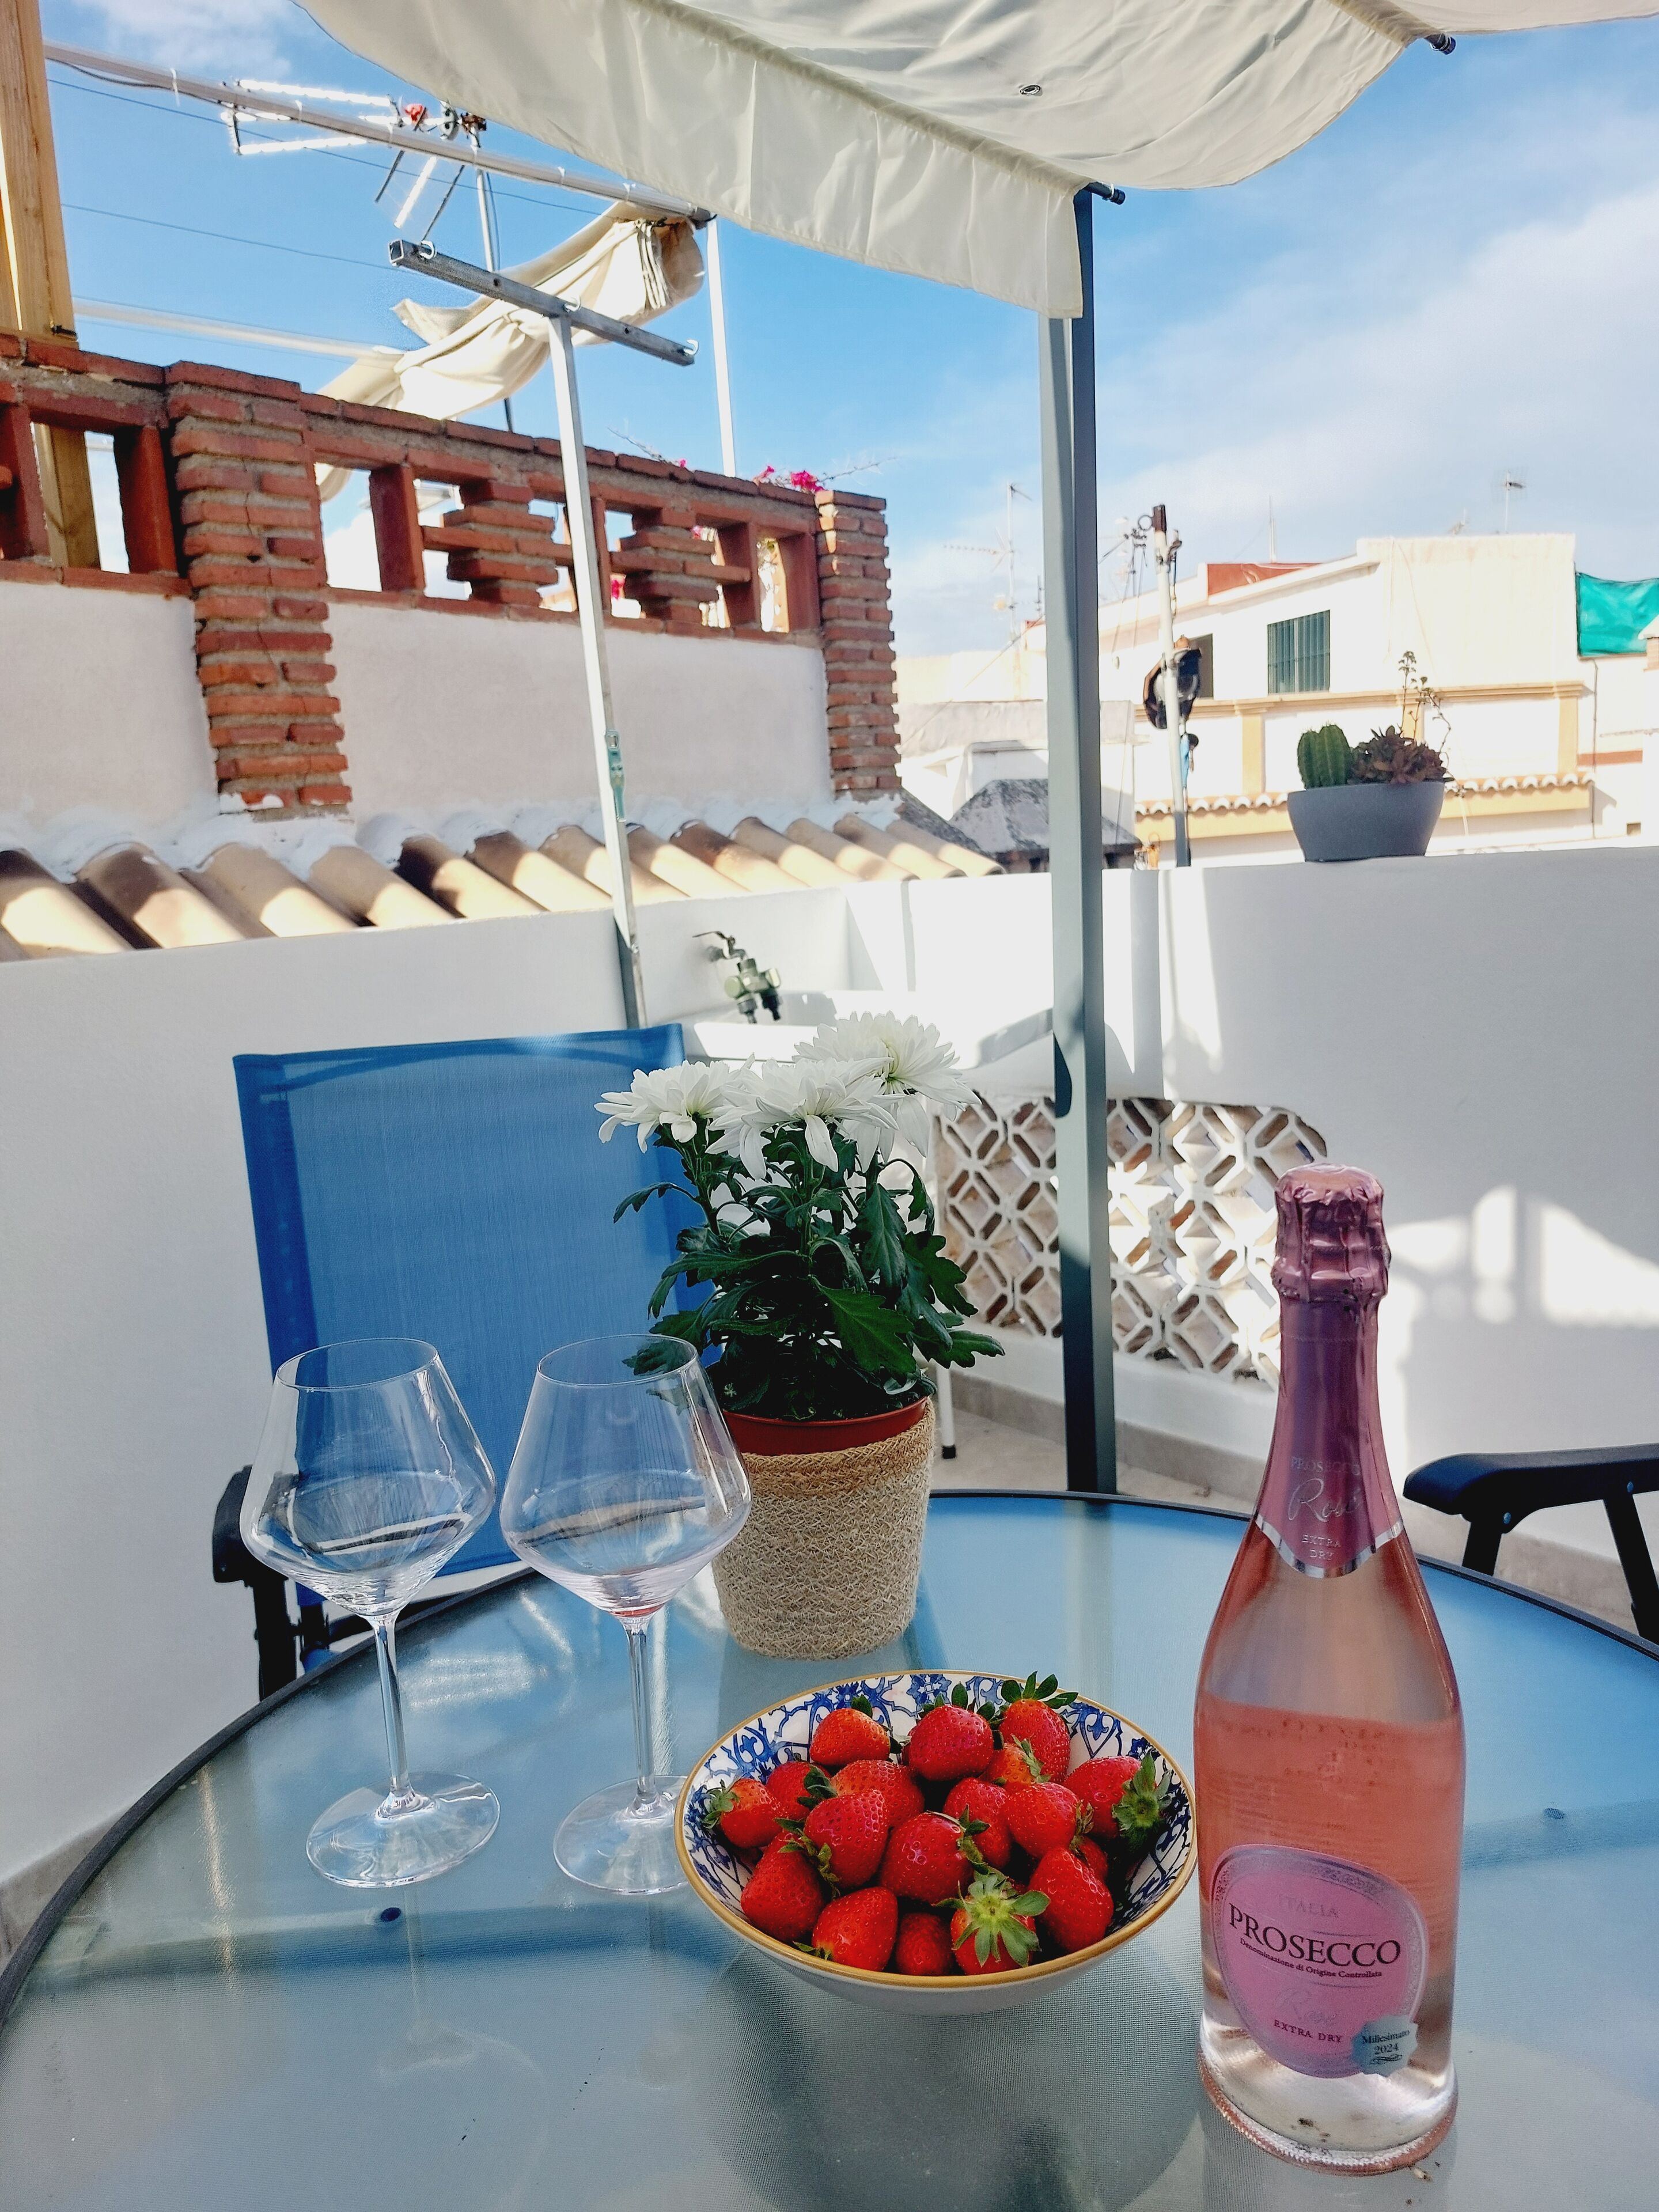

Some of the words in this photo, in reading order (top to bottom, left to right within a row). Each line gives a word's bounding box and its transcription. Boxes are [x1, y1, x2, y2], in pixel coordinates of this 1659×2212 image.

[1229, 1903, 1401, 1967] PROSECCO
[1240, 1937, 1294, 1968] Denominazione
[1306, 1966, 1336, 1977] Origine
[1274, 2019, 1313, 2039] EXTRA
[1318, 2032, 1343, 2043] DRY
[1374, 2043, 1399, 2055] 2024
